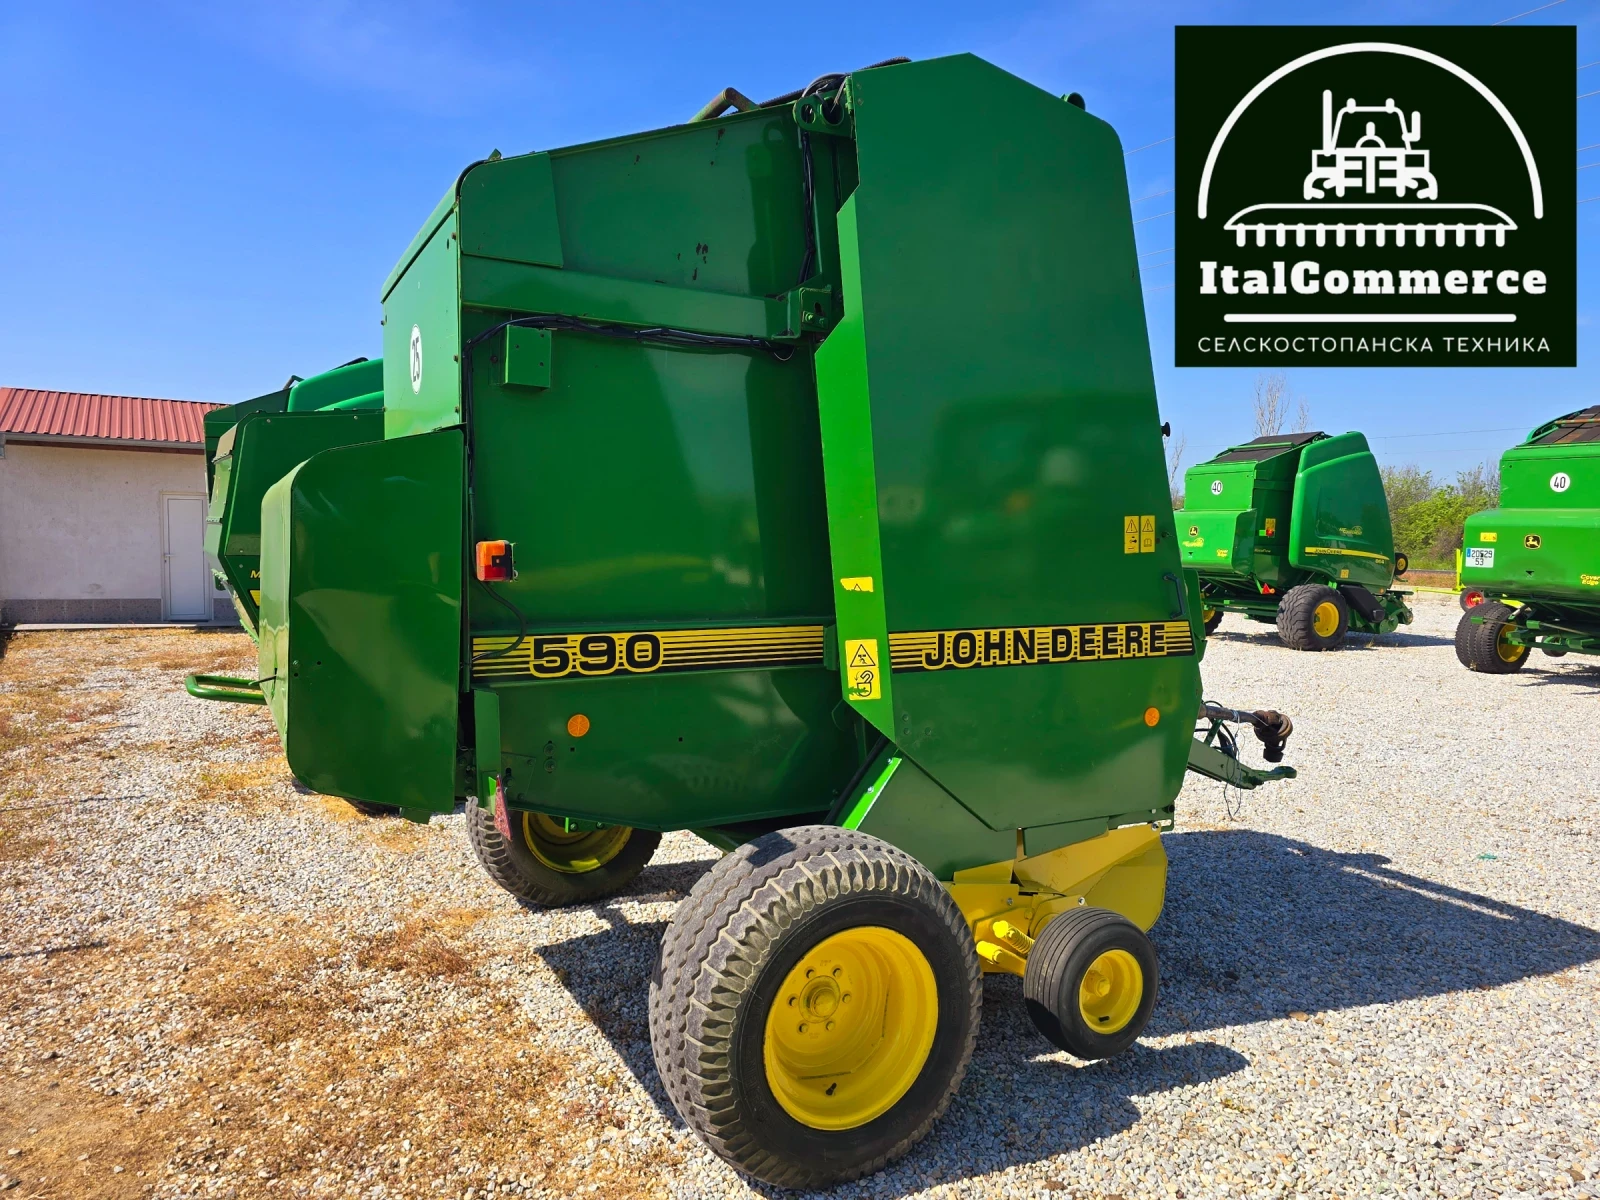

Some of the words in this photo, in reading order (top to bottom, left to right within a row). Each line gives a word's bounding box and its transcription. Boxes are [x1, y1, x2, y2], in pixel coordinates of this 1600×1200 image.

[412, 336, 421, 382] 25
[1211, 482, 1222, 492] 40
[1553, 476, 1566, 489] 40
[1475, 557, 1484, 566] 53
[529, 632, 664, 678] 590
[922, 628, 1038, 671] JOHN
[1049, 622, 1167, 661] DEERE
